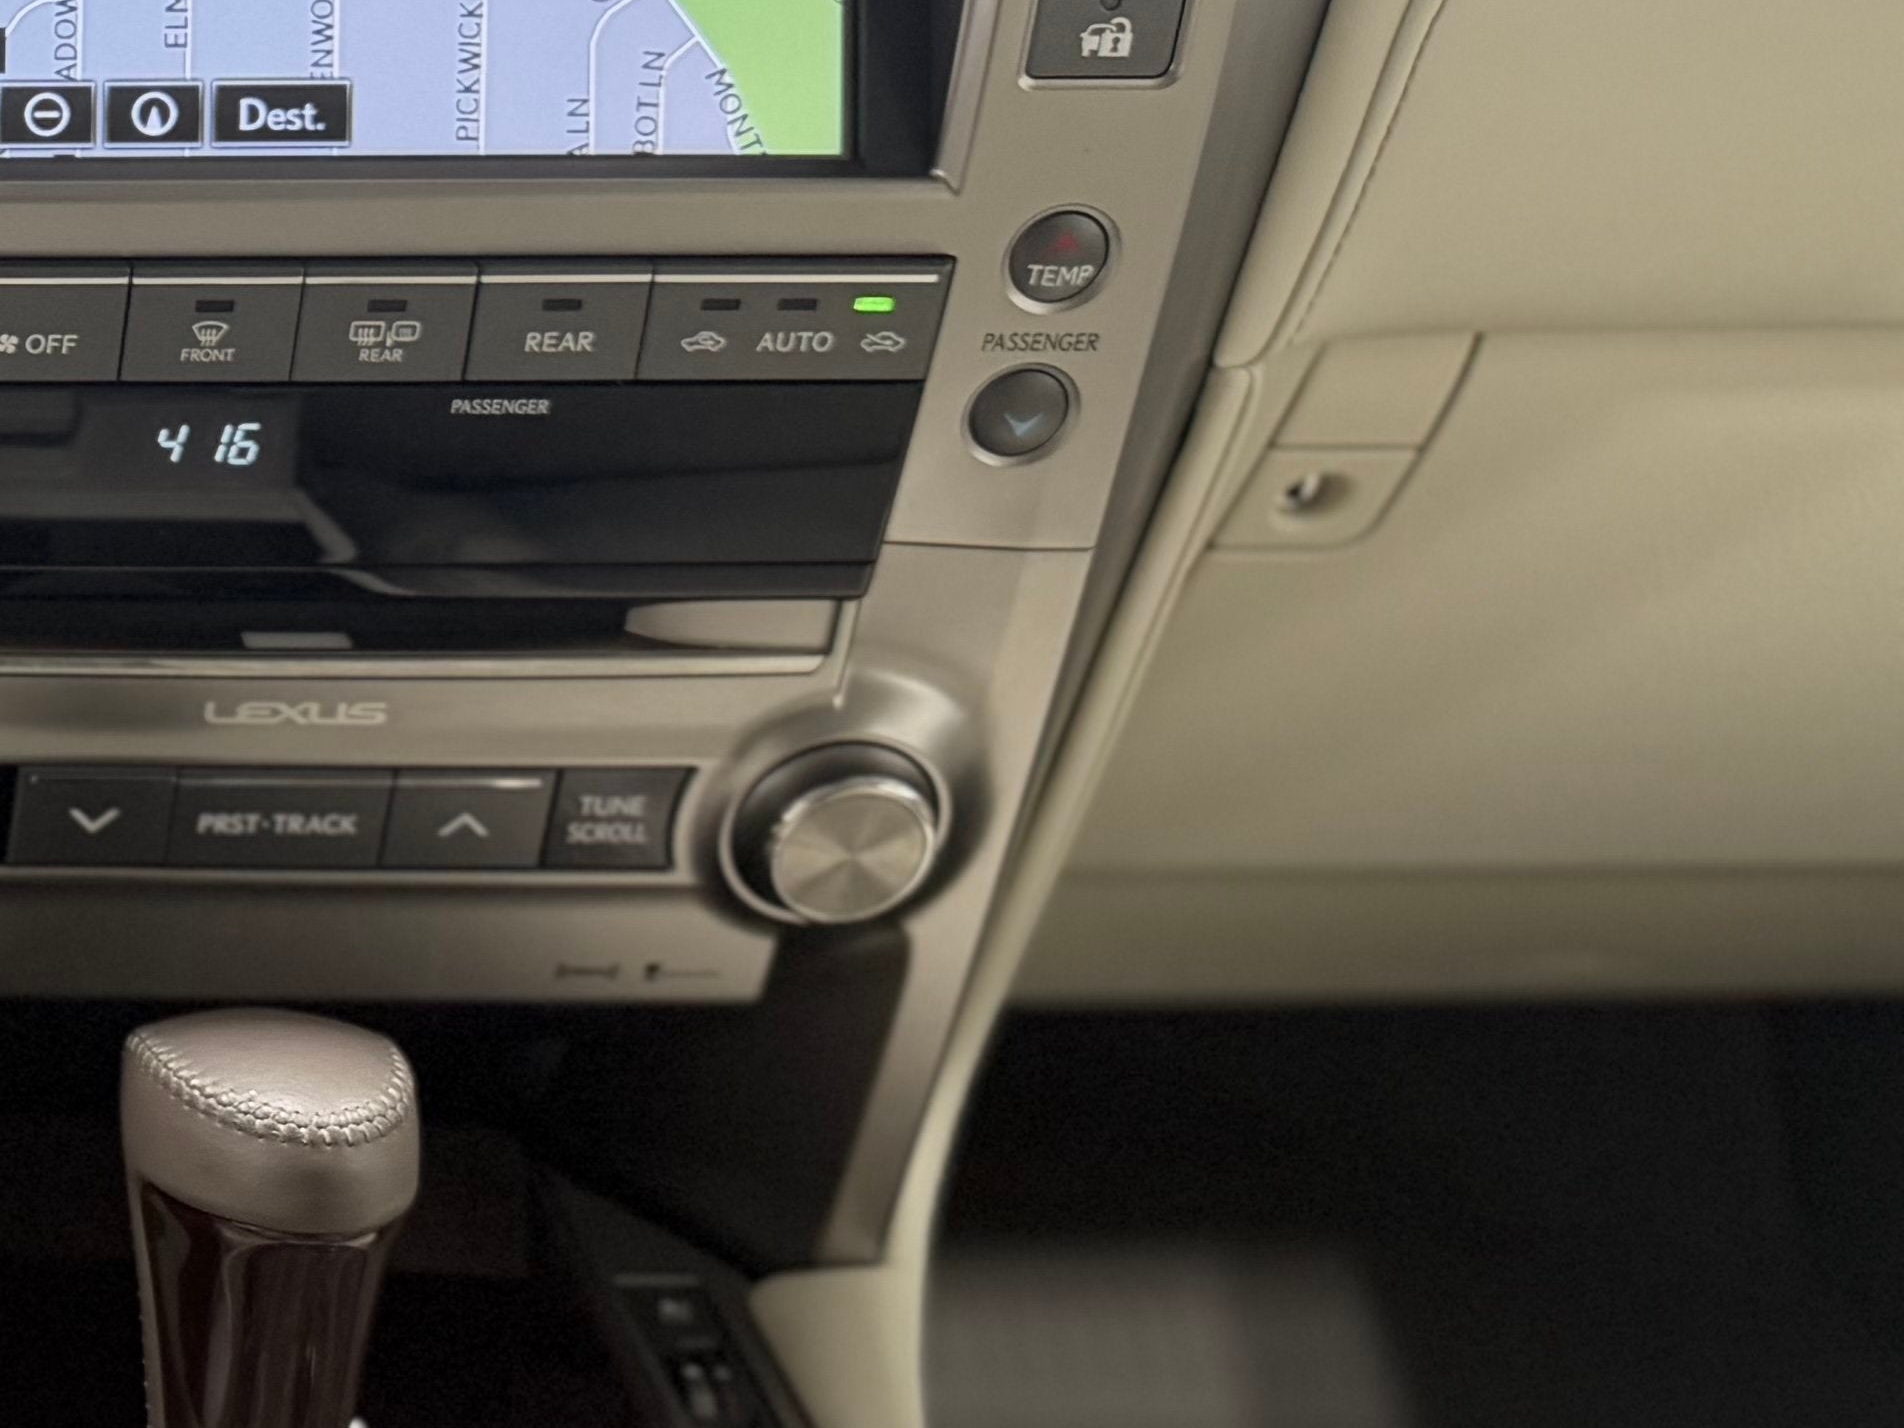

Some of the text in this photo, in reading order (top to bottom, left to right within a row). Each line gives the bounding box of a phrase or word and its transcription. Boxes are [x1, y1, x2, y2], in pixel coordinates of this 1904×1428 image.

[456, 3, 483, 143] PICKWICK
[639, 50, 666, 88] LN
[239, 98, 325, 132] Dest.
[566, 97, 590, 134] LN
[1027, 264, 1094, 286] TEMP
[25, 334, 79, 355] OFF
[524, 332, 594, 353] REAR
[756, 331, 835, 353] AUTO
[981, 332, 1100, 353] PASSENGER
[180, 348, 236, 362] FRONT
[358, 348, 403, 362] REAR
[450, 399, 551, 415] PASSENGER
[204, 701, 388, 725] LEXUS
[579, 795, 645, 817] TUNE
[567, 822, 649, 844] SCROLL
